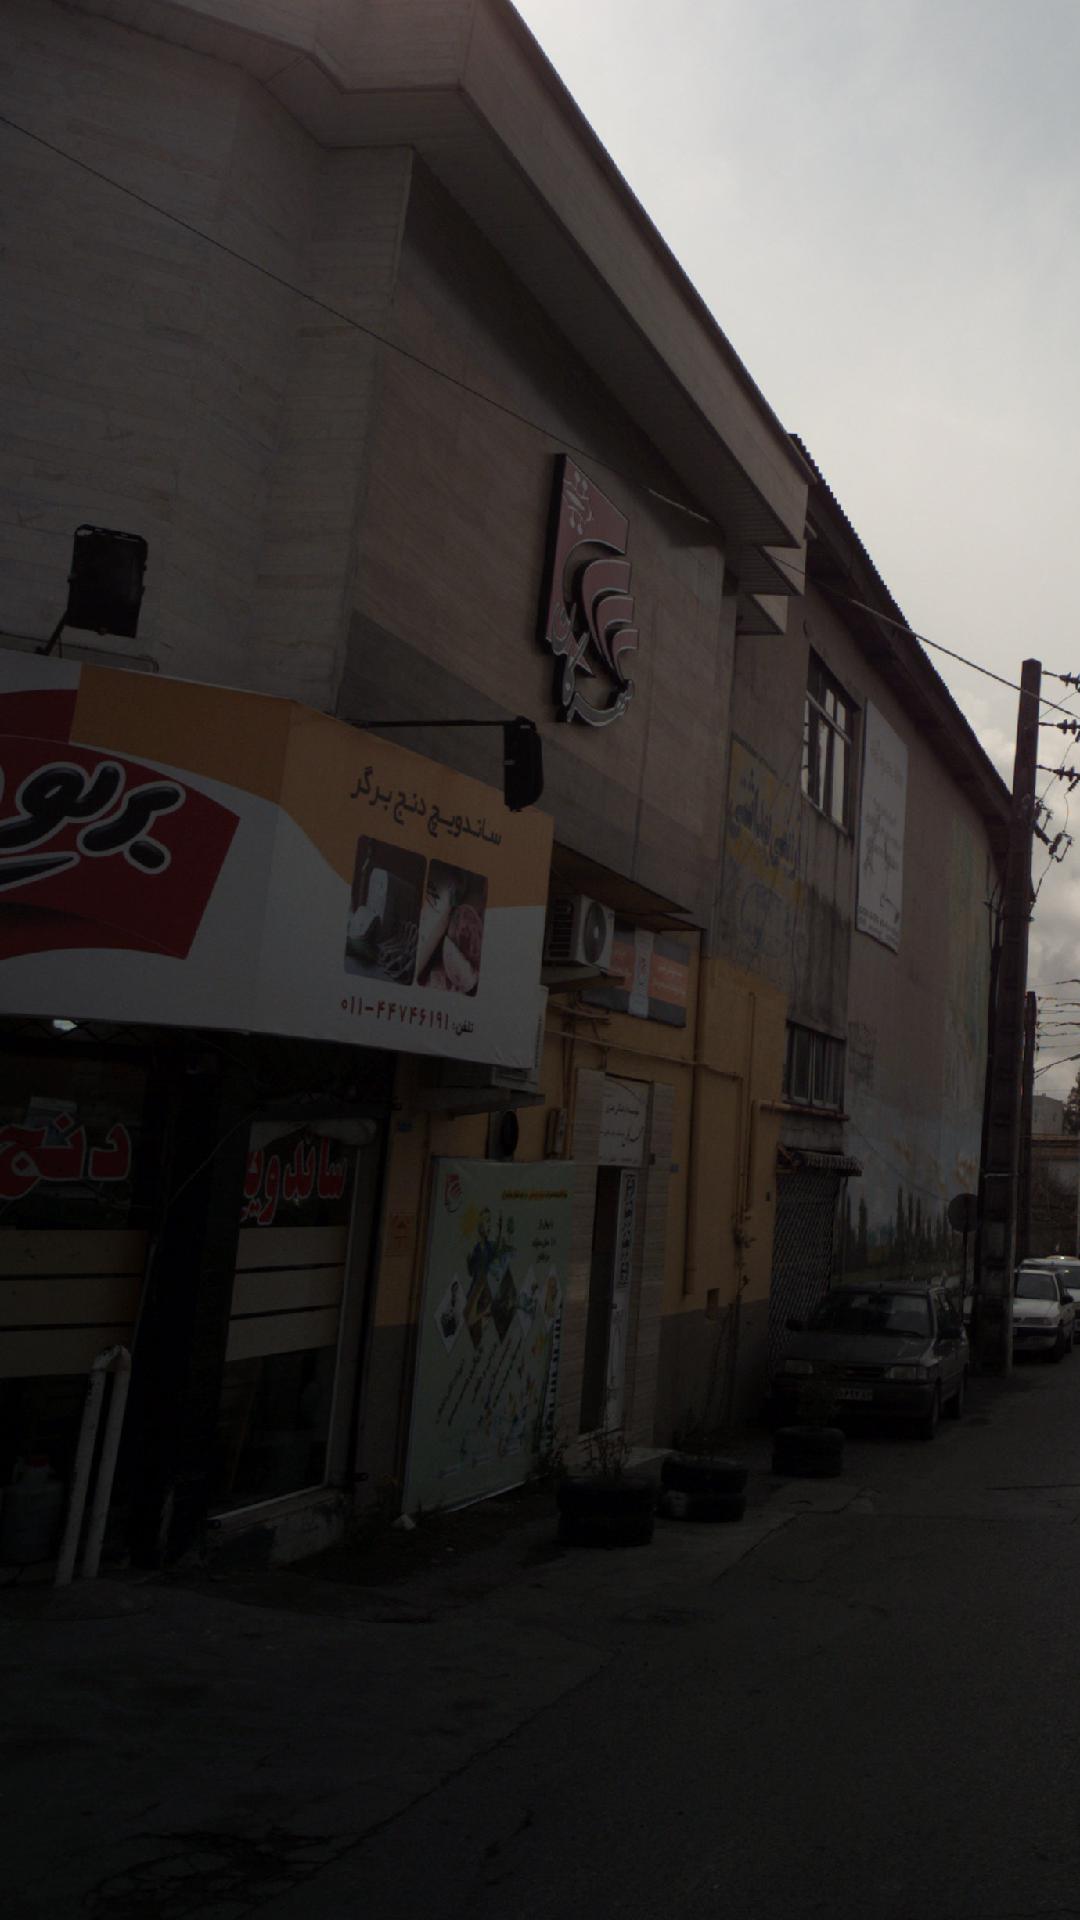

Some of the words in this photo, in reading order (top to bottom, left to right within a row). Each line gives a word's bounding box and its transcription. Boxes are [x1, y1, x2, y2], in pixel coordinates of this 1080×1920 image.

[350, 766, 392, 811] برگر
[393, 791, 426, 824] دنج
[427, 805, 502, 845] ساندویچ
